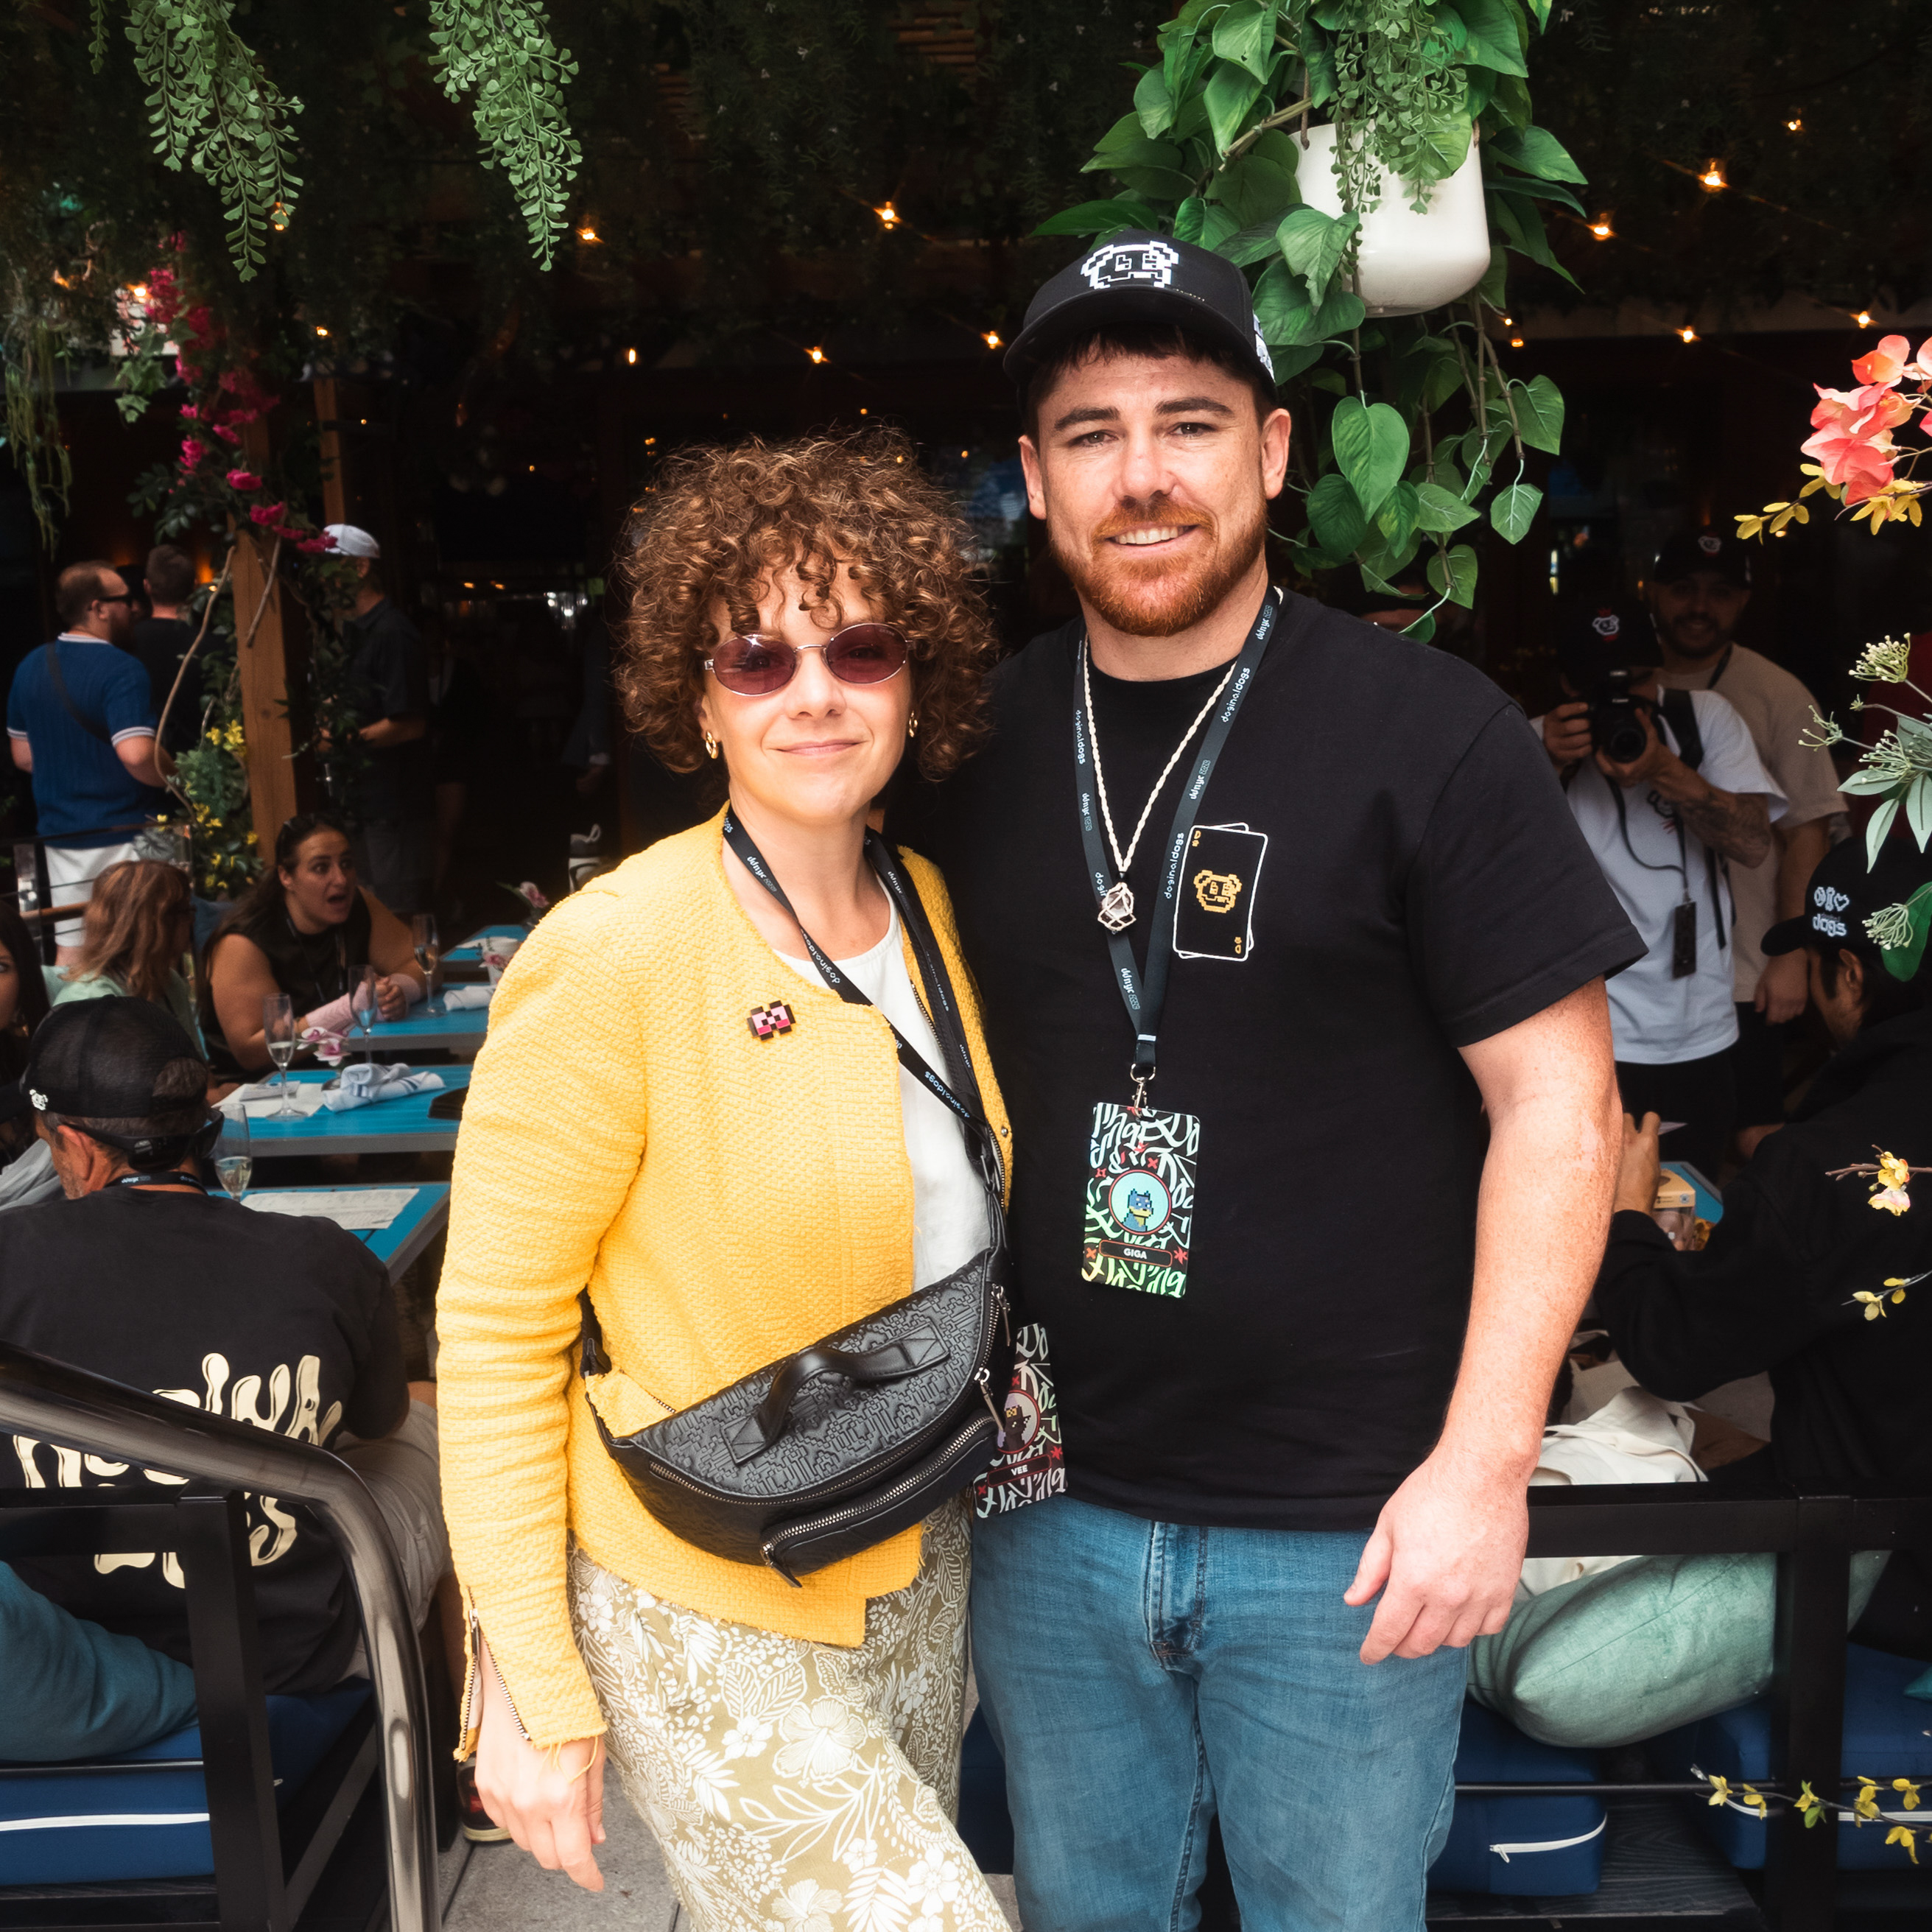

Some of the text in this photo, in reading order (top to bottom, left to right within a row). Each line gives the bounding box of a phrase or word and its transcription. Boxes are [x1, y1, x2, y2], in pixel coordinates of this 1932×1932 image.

[1220, 667, 1251, 723] doginaldogs
[1164, 832, 1184, 899] doginaldogs
[1812, 913, 1847, 938] dogs
[1123, 1248, 1148, 1260] GIGA
[1011, 1464, 1028, 1476] VEE
